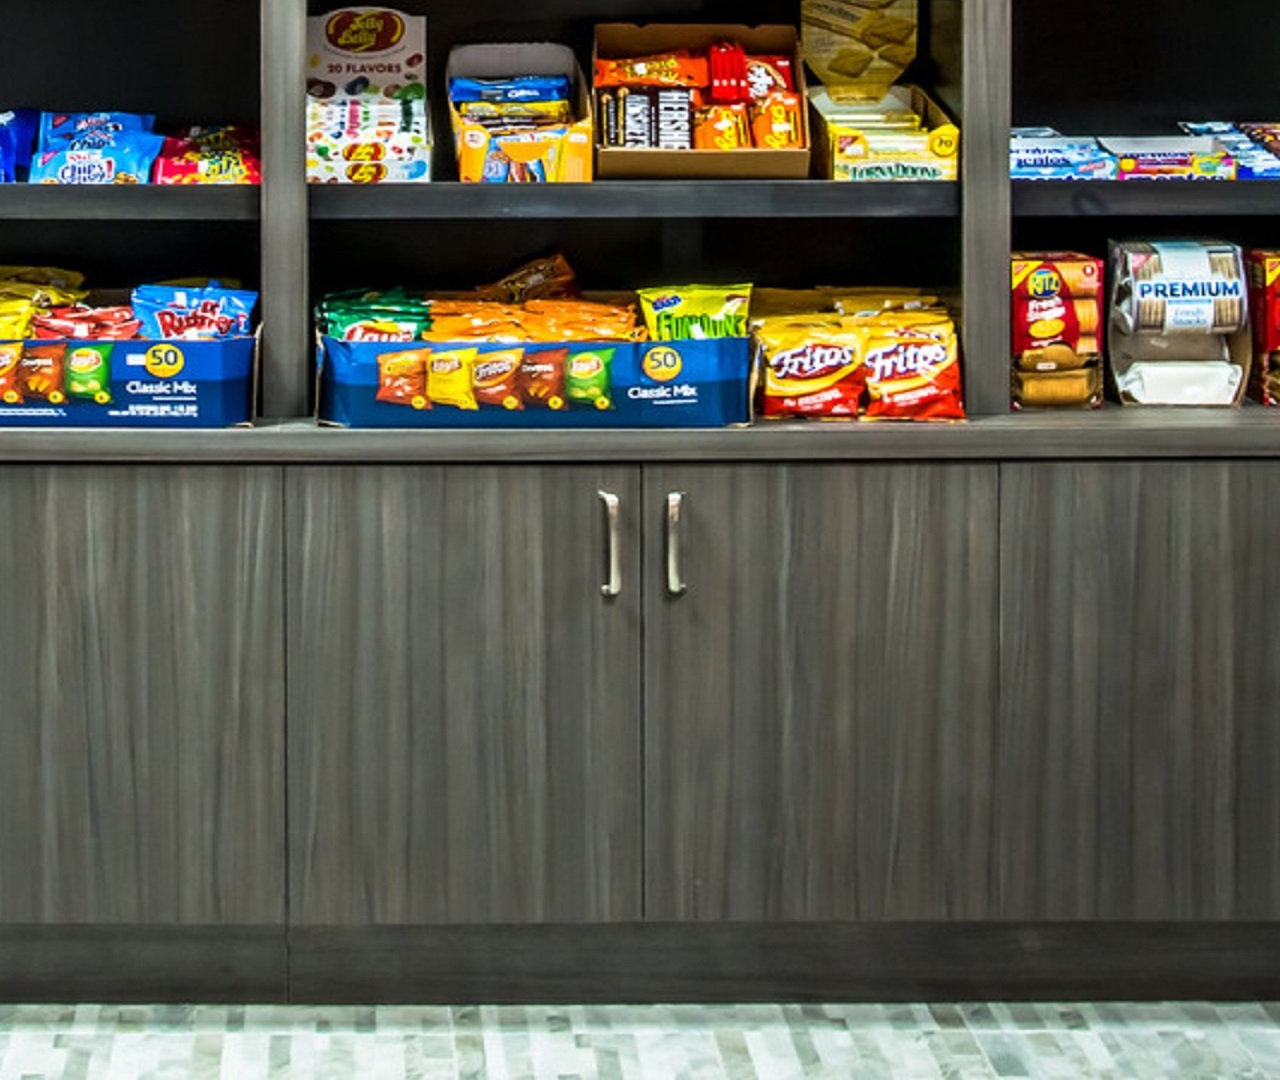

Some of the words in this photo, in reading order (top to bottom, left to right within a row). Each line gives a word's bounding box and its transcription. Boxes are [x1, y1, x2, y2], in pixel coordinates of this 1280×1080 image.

[346, 63, 402, 74] FLAVORS
[659, 90, 691, 149] HERSHE
[1140, 281, 1240, 298] PREMIUM
[149, 350, 178, 366] 50
[649, 353, 677, 370] 50
[771, 346, 854, 379] Fritos
[865, 344, 947, 383] Fritos
[126, 381, 170, 394] Classic
[173, 381, 198, 394] Mix
[628, 385, 671, 399] Classic
[673, 384, 698, 398] Mix
